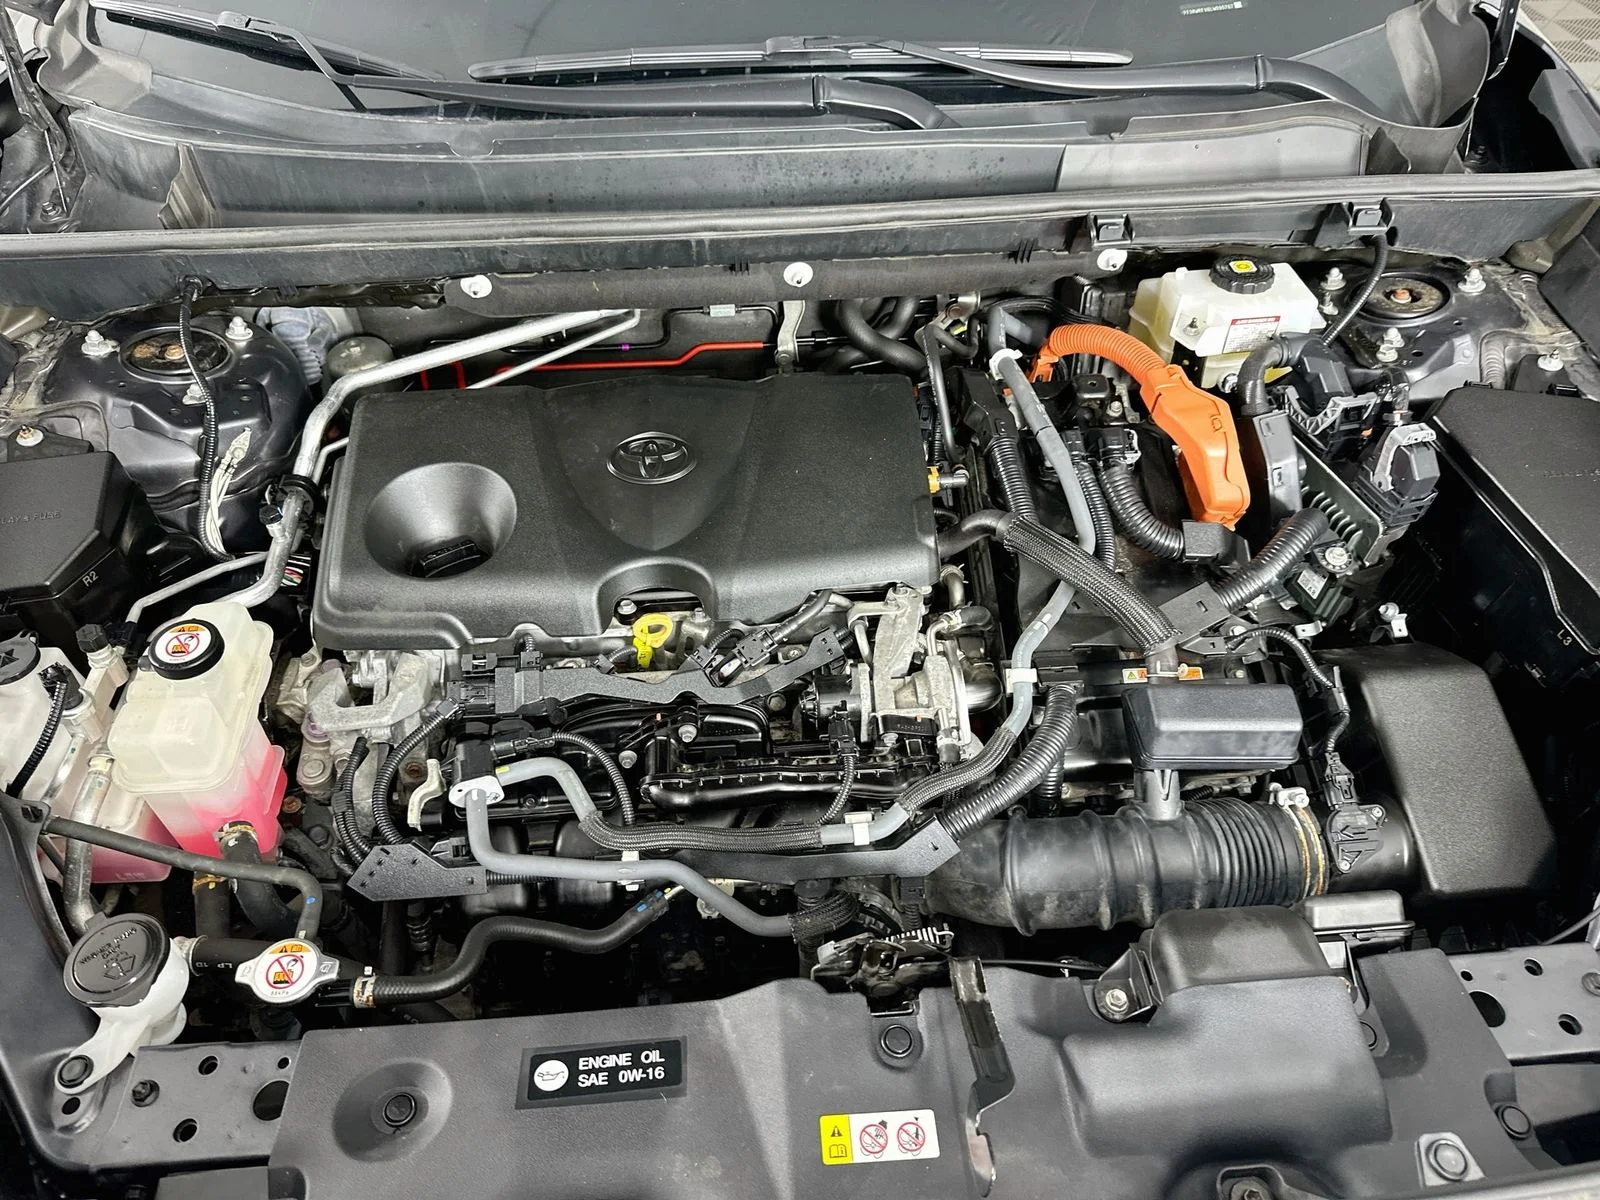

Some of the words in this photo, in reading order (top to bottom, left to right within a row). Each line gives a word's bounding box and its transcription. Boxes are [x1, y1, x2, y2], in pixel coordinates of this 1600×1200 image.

[82, 571, 99, 587] R2
[1556, 629, 1573, 646] L3
[578, 1053, 632, 1071] ENGINE
[640, 1049, 666, 1063] OIL
[577, 1072, 609, 1087] SAE
[618, 1066, 665, 1083] 0W-16
